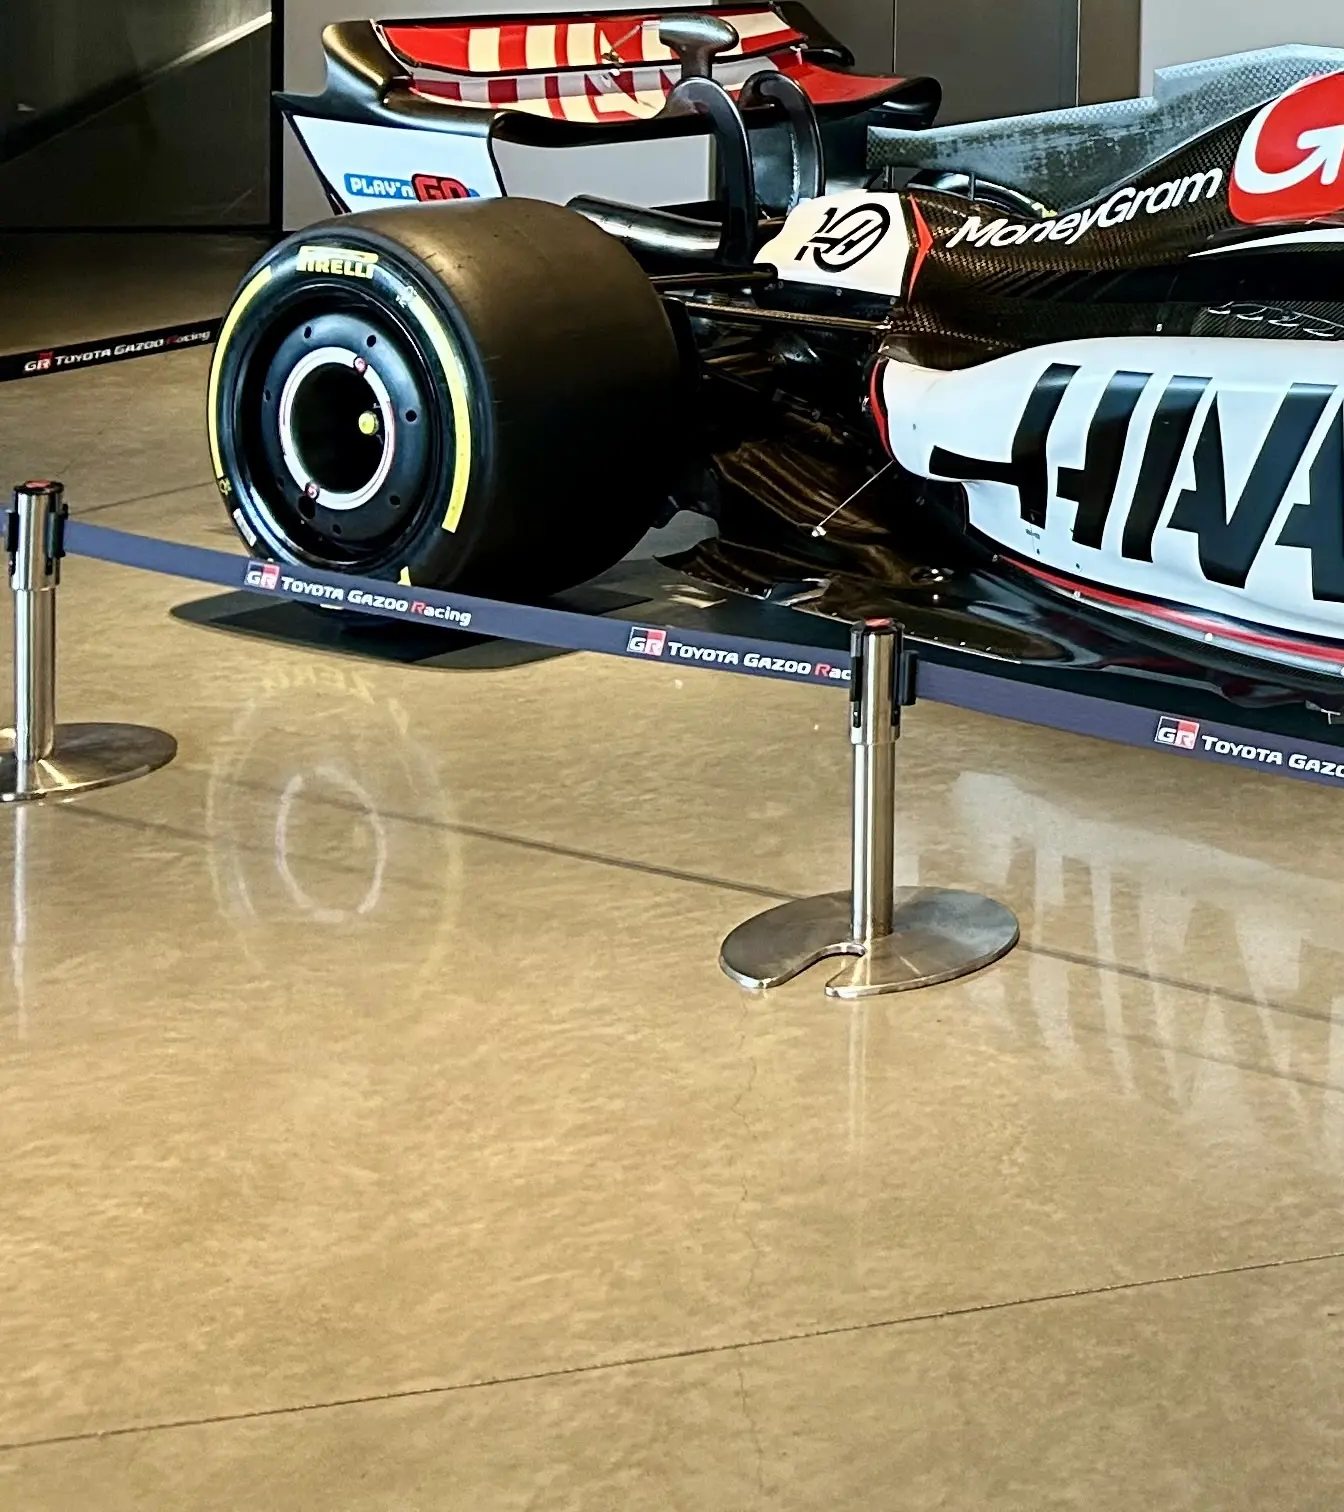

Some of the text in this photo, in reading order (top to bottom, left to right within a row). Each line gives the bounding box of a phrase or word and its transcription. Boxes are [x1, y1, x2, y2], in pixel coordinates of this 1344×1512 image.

[946, 168, 1223, 250] MoneyGram
[296, 245, 379, 280] PIRELLI
[55, 349, 111, 367] TOYOTA
[113, 338, 164, 355] GAZOO
[166, 331, 211, 345] Racing
[280, 576, 344, 600] TOYOTA
[347, 589, 408, 612] GAZOO
[410, 600, 472, 627] Racing
[668, 641, 739, 665] TOYOTA
[743, 653, 812, 676] GAZOO
[814, 662, 851, 681] Rac
[1201, 734, 1284, 765] TOYOTA
